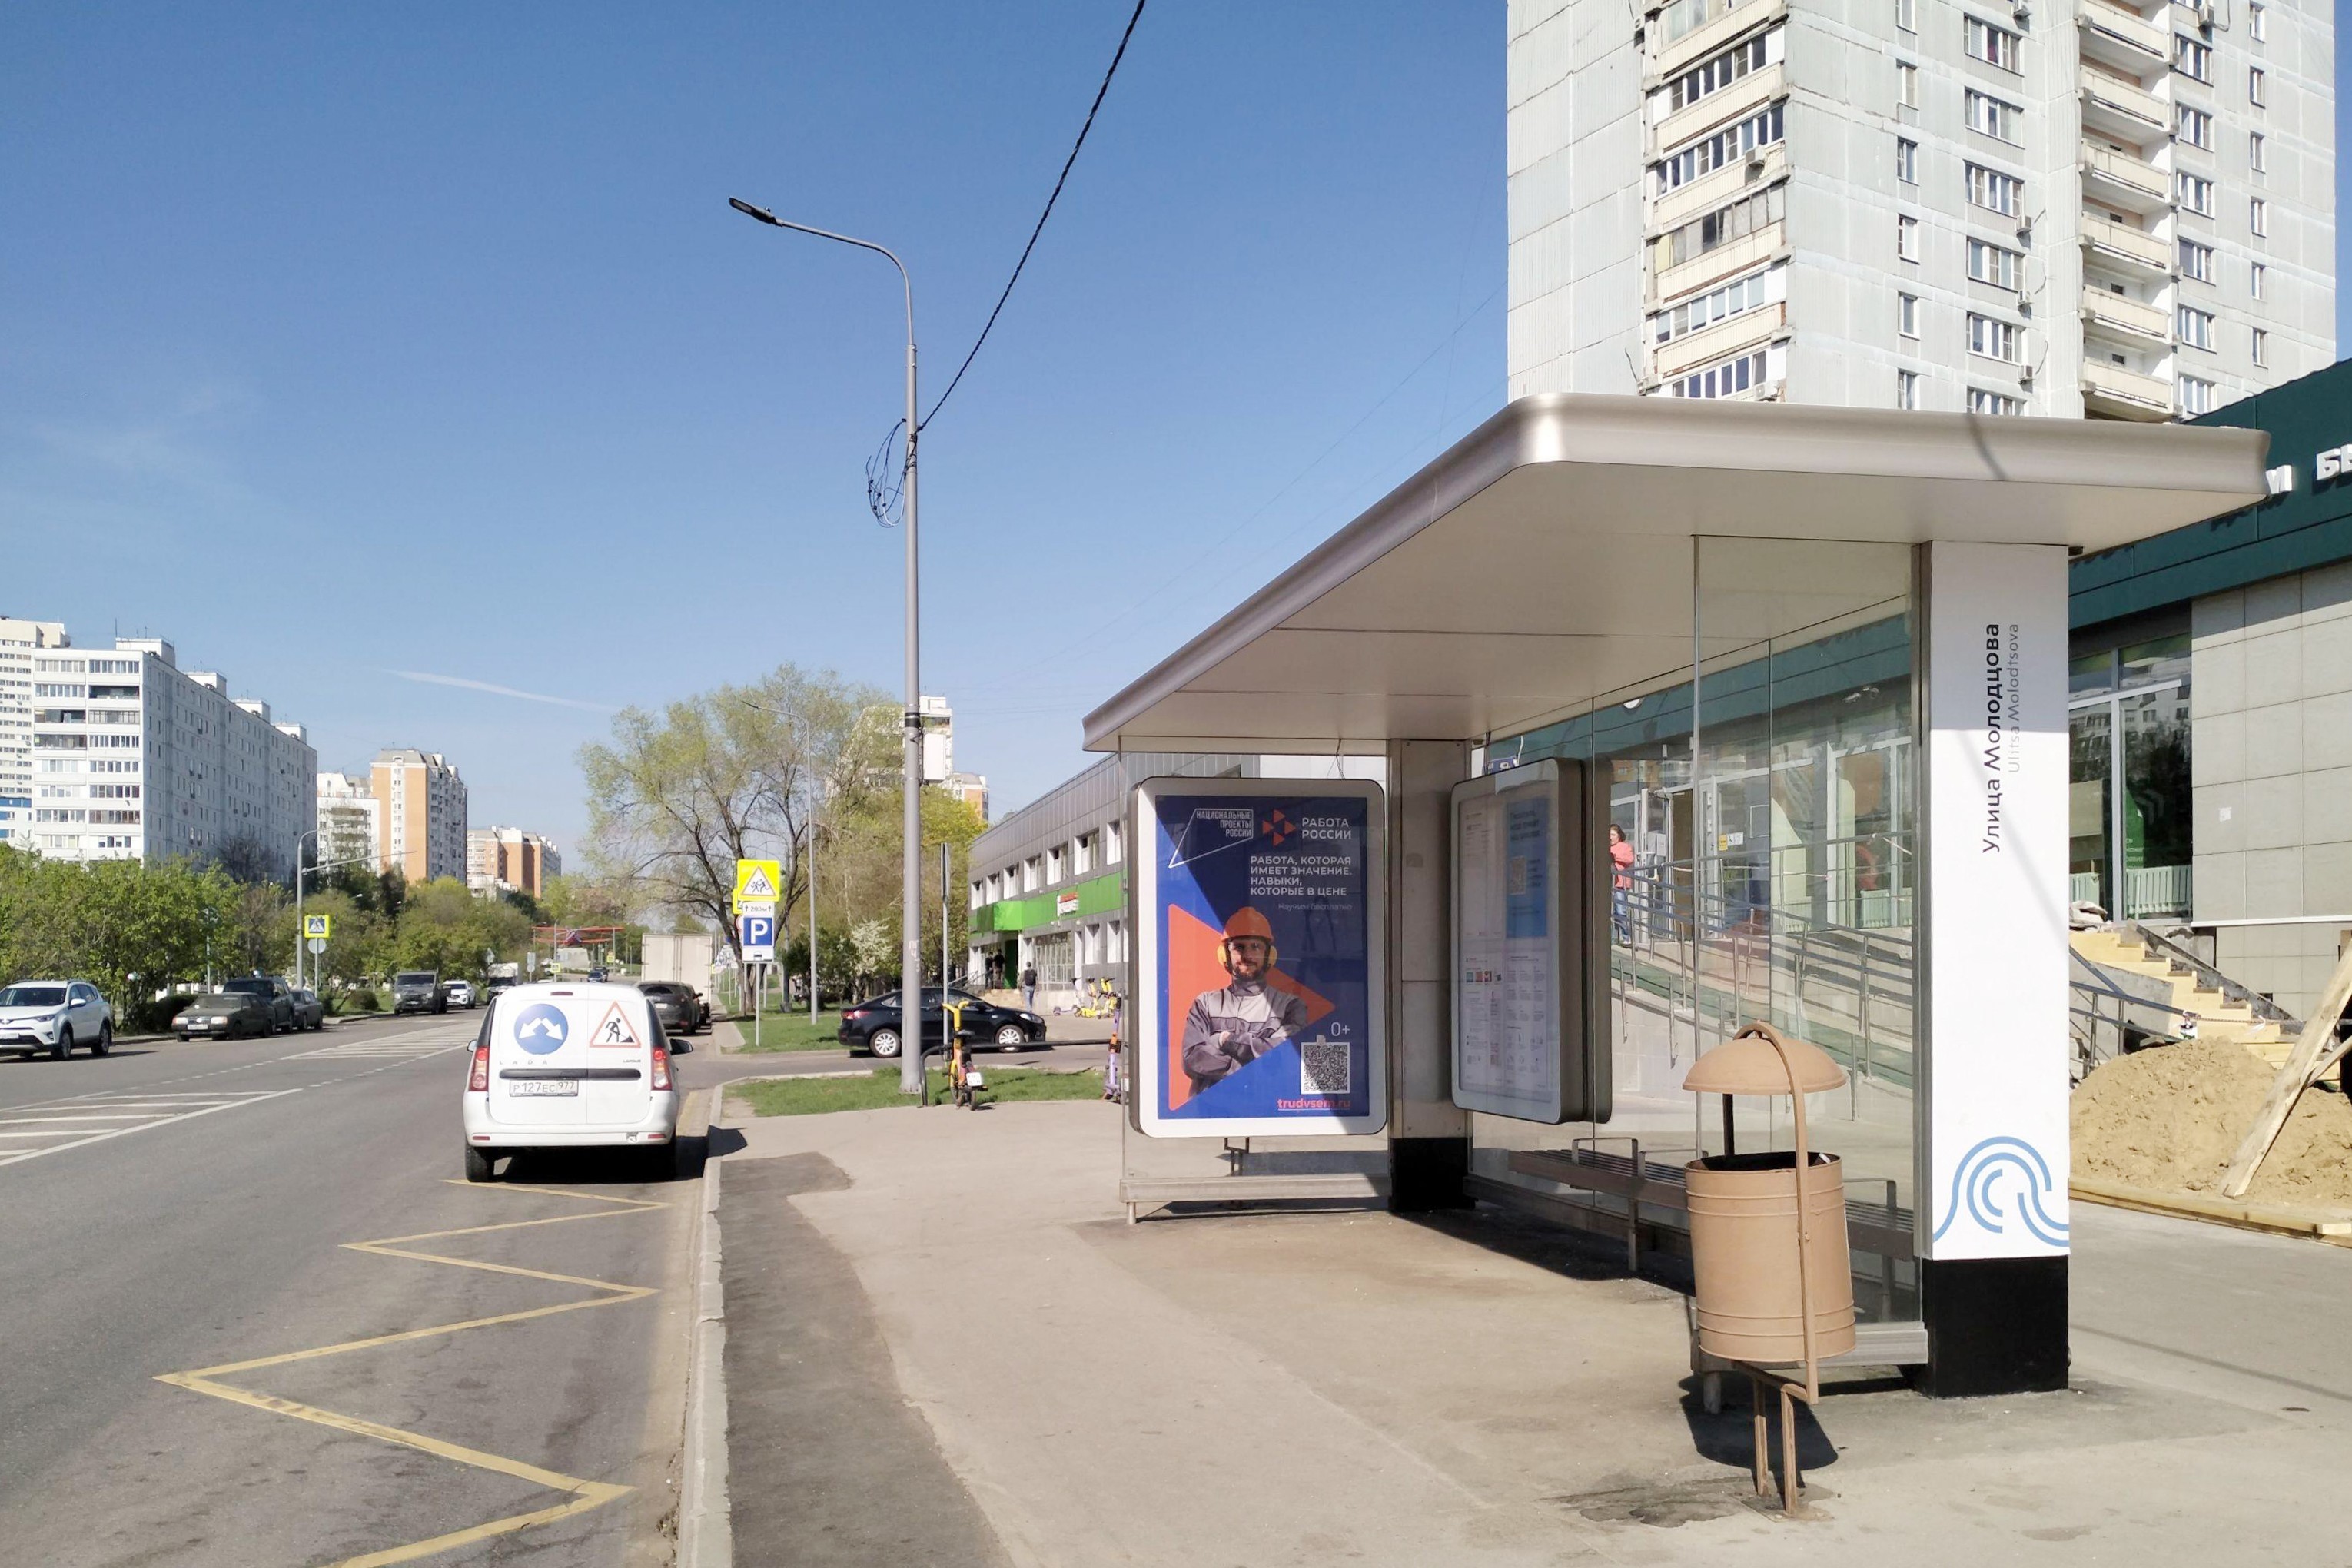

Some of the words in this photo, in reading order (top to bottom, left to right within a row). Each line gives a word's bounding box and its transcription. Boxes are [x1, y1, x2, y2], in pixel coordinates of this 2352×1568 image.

[2007, 623, 2019, 721] Molodtsova
[1984, 623, 2002, 771] Молодцова
[2008, 726, 2020, 773] Ulitsa
[1196, 810, 1251, 820] НАЦИОНАЛЬНЫЕ
[1982, 779, 2002, 853] Улица
[1220, 819, 1251, 829] ПРОЕКТЫ
[1301, 817, 1349, 828] РАБОТА
[1225, 829, 1251, 837] РОССИИ
[1301, 829, 1351, 839] РОССИИ
[1251, 855, 1298, 865] РАБОТА,
[1301, 856, 1351, 865] КОТОРАЯ
[1251, 866, 1287, 875] ИМЕЕТ
[1291, 866, 1353, 875] ЗНАЧЕНИЕ.
[1251, 877, 1302, 886] НАВЫКИ,
[1251, 887, 1304, 895] КОТОРЫЕ
[1307, 887, 1314, 895] В
[1317, 887, 1347, 897] ЦЕНЕ
[1330, 1022, 1350, 1037] 0+
[1277, 1098, 1351, 1108] trudvsem.ru
